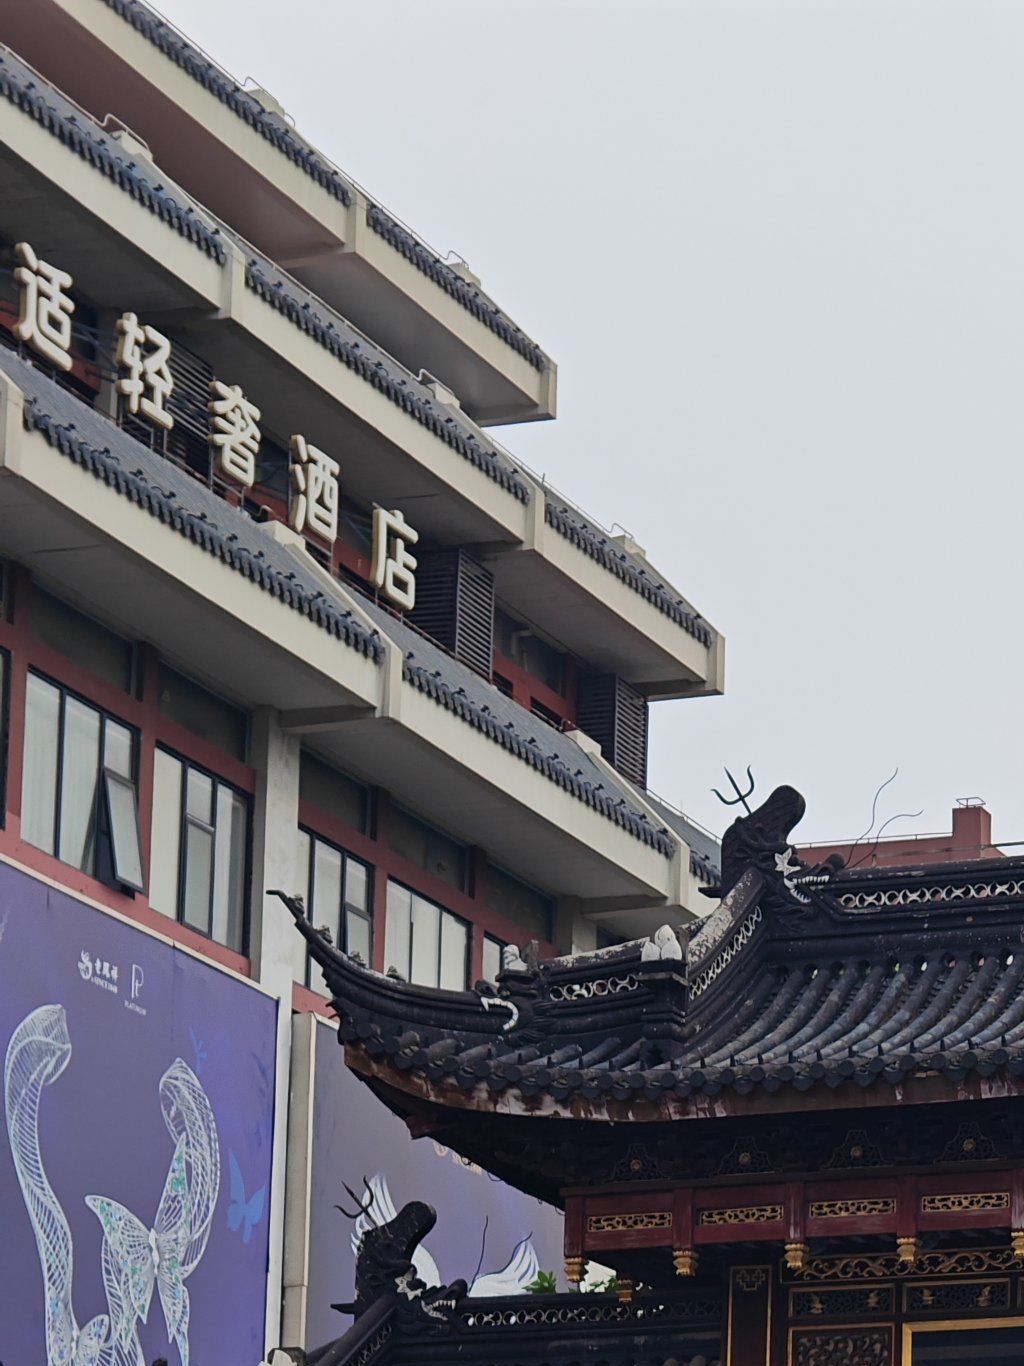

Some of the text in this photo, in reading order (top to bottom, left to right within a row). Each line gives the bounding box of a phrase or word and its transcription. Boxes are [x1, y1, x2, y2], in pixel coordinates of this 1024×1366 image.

[14, 242, 419, 611] 适轻奢酒店
